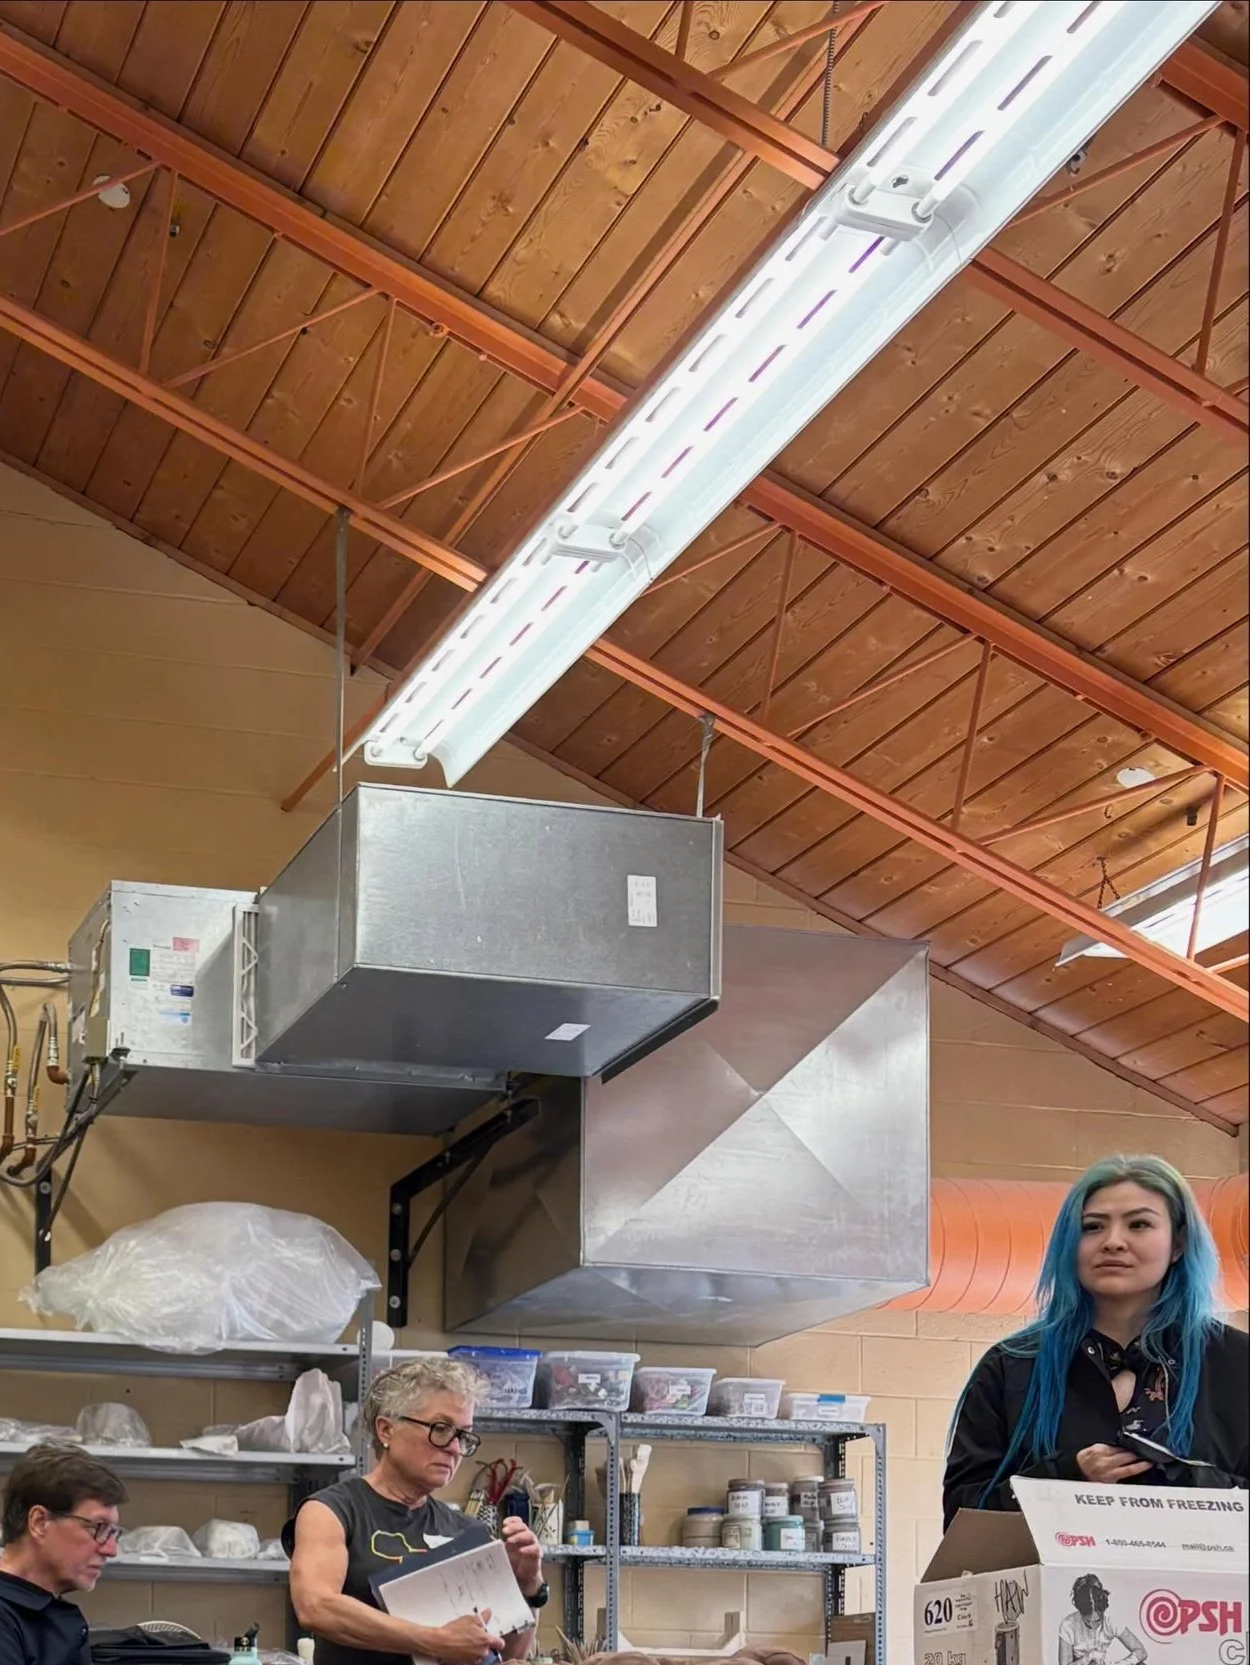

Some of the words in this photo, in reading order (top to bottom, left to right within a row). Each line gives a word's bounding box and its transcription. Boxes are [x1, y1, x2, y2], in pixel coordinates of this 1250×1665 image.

[1074, 1494, 1115, 1506] KEEP
[1119, 1496, 1164, 1509] FROM
[1168, 1499, 1244, 1512] FREEZING
[924, 1597, 953, 1626] 620
